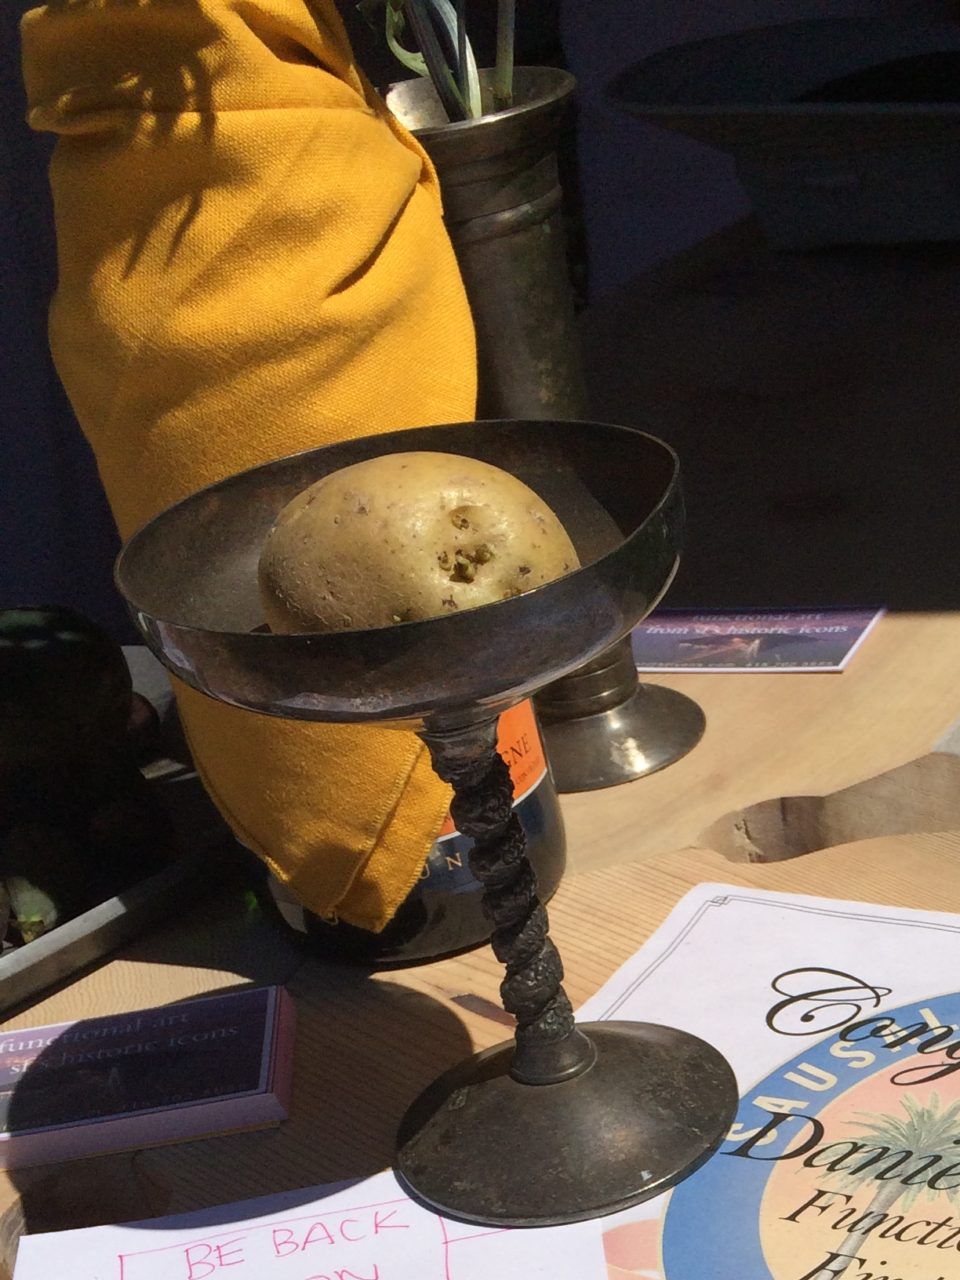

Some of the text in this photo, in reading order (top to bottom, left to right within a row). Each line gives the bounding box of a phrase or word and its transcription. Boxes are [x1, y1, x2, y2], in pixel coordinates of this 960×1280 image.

[799, 623, 848, 634] icons
[152, 1012, 191, 1028] art
[60, 1038, 158, 1064] historic
[168, 1024, 239, 1047] icons
[184, 1208, 411, 1280] BE BACK
